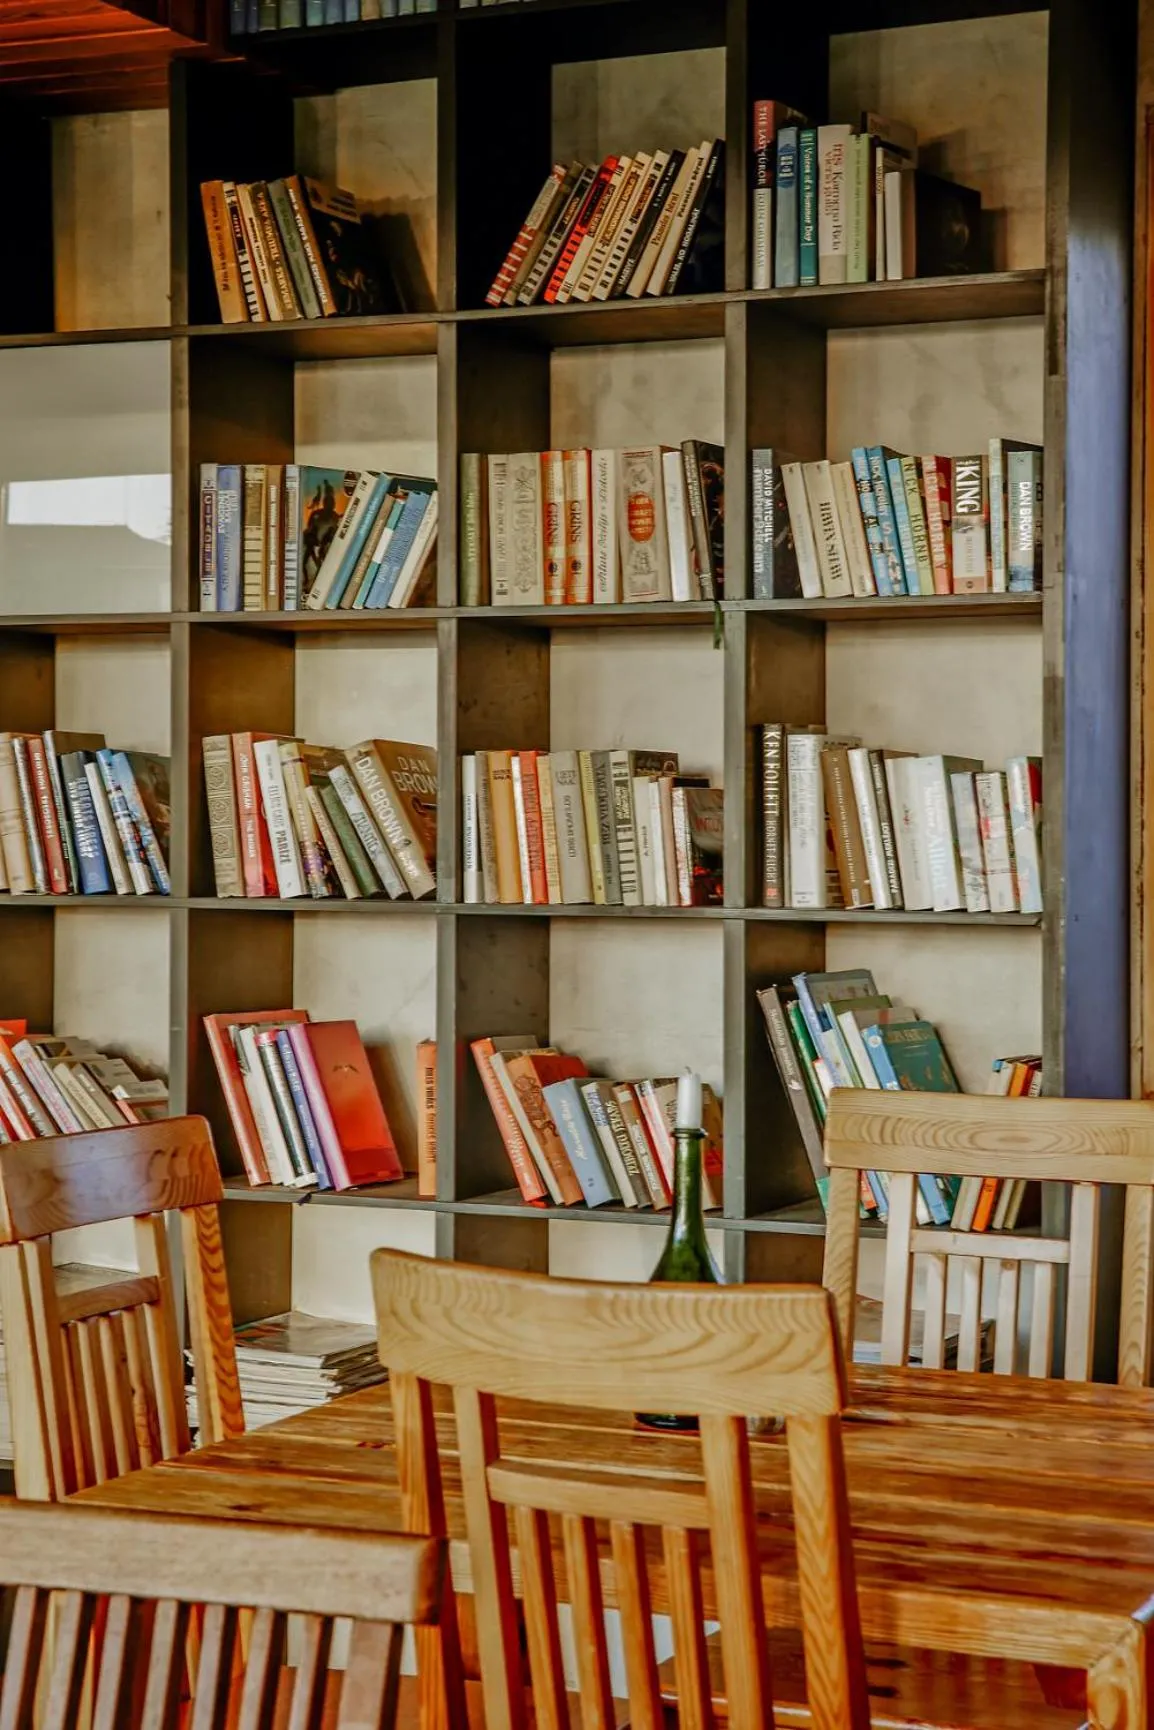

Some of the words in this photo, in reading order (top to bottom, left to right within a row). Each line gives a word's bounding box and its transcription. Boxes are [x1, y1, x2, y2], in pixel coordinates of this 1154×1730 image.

[759, 106, 767, 125] THE
[764, 468, 773, 496] DAVID
[955, 465, 980, 513] KING
[1019, 481, 1031, 505] DAN
[764, 498, 772, 542] MITCHELL
[1018, 508, 1032, 550] BROWN
[764, 731, 780, 761] KEN
[397, 757, 430, 773] DAN
[354, 755, 381, 789] DAN
[369, 787, 406, 845] BROWN
[764, 767, 779, 816] FOLLETT
